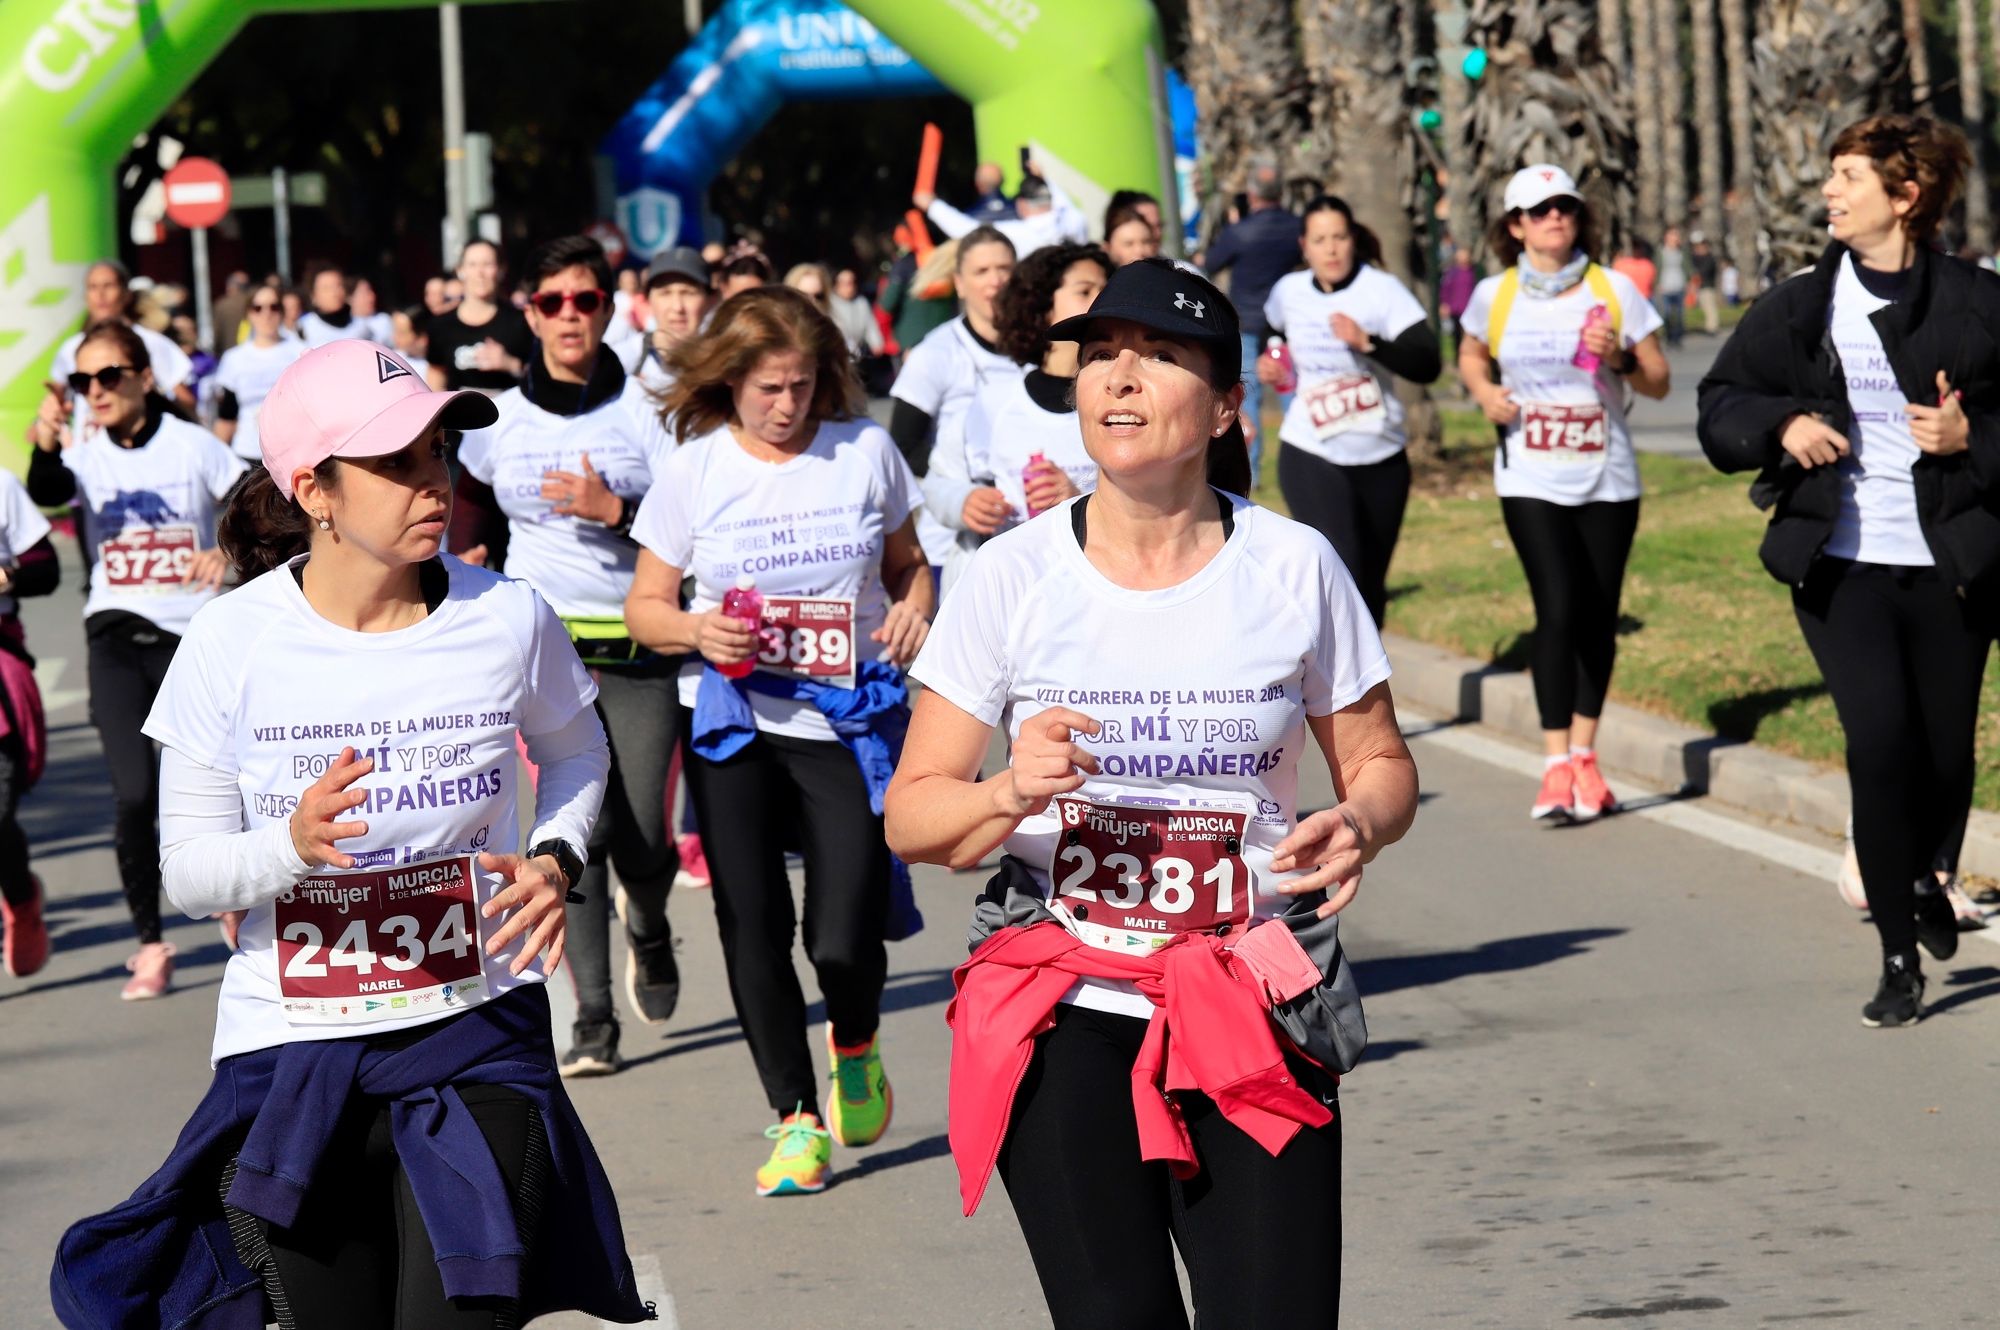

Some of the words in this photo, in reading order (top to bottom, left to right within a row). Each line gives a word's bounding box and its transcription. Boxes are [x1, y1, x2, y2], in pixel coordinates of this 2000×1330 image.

[1526, 418, 1603, 449] 1754
[733, 516, 779, 530] CARRERA
[781, 513, 794, 523] DE
[797, 511, 810, 520] LA
[812, 506, 845, 518] MUJER
[771, 523, 797, 547] MÍ
[742, 540, 875, 574] COMPAÑERAS
[800, 602, 847, 615] MURCIA
[758, 627, 849, 666] 389
[1036, 688, 1065, 704] VIII
[1068, 689, 1144, 705] CARRERA
[1149, 690, 1171, 705] DE
[1177, 690, 1198, 705] LA
[1202, 689, 1256, 705] MUJER
[1259, 684, 1285, 702] 2023
[253, 726, 286, 742] VIII
[291, 721, 365, 740] CARRERA
[370, 720, 391, 736] DE
[397, 718, 418, 734] LA
[422, 714, 474, 732] MUJER
[479, 711, 511, 727] 2023
[1131, 707, 1172, 741] MÍ
[1177, 719, 1199, 742] Y
[1204, 718, 1259, 743] POR
[397, 748, 417, 772] Y
[422, 743, 474, 770] POR
[254, 793, 298, 819] MIS
[338, 768, 502, 818] MPAÑERAS
[1091, 815, 1151, 846] mujer
[1168, 816, 1236, 832] MURCIA
[1167, 833, 1173, 841] 5
[1175, 834, 1187, 842] DE
[1188, 833, 1218, 842] MARZO
[308, 886, 372, 915] mujer
[388, 863, 462, 891] MURCIA
[389, 892, 396, 900] 5
[398, 890, 410, 900] DE
[411, 884, 443, 897] MARZO
[444, 878, 465, 891] 2023
[1059, 845, 1234, 914] 2381
[1124, 916, 1167, 930] MAITE
[282, 902, 473, 978] 2434
[358, 979, 405, 993] NAREL
